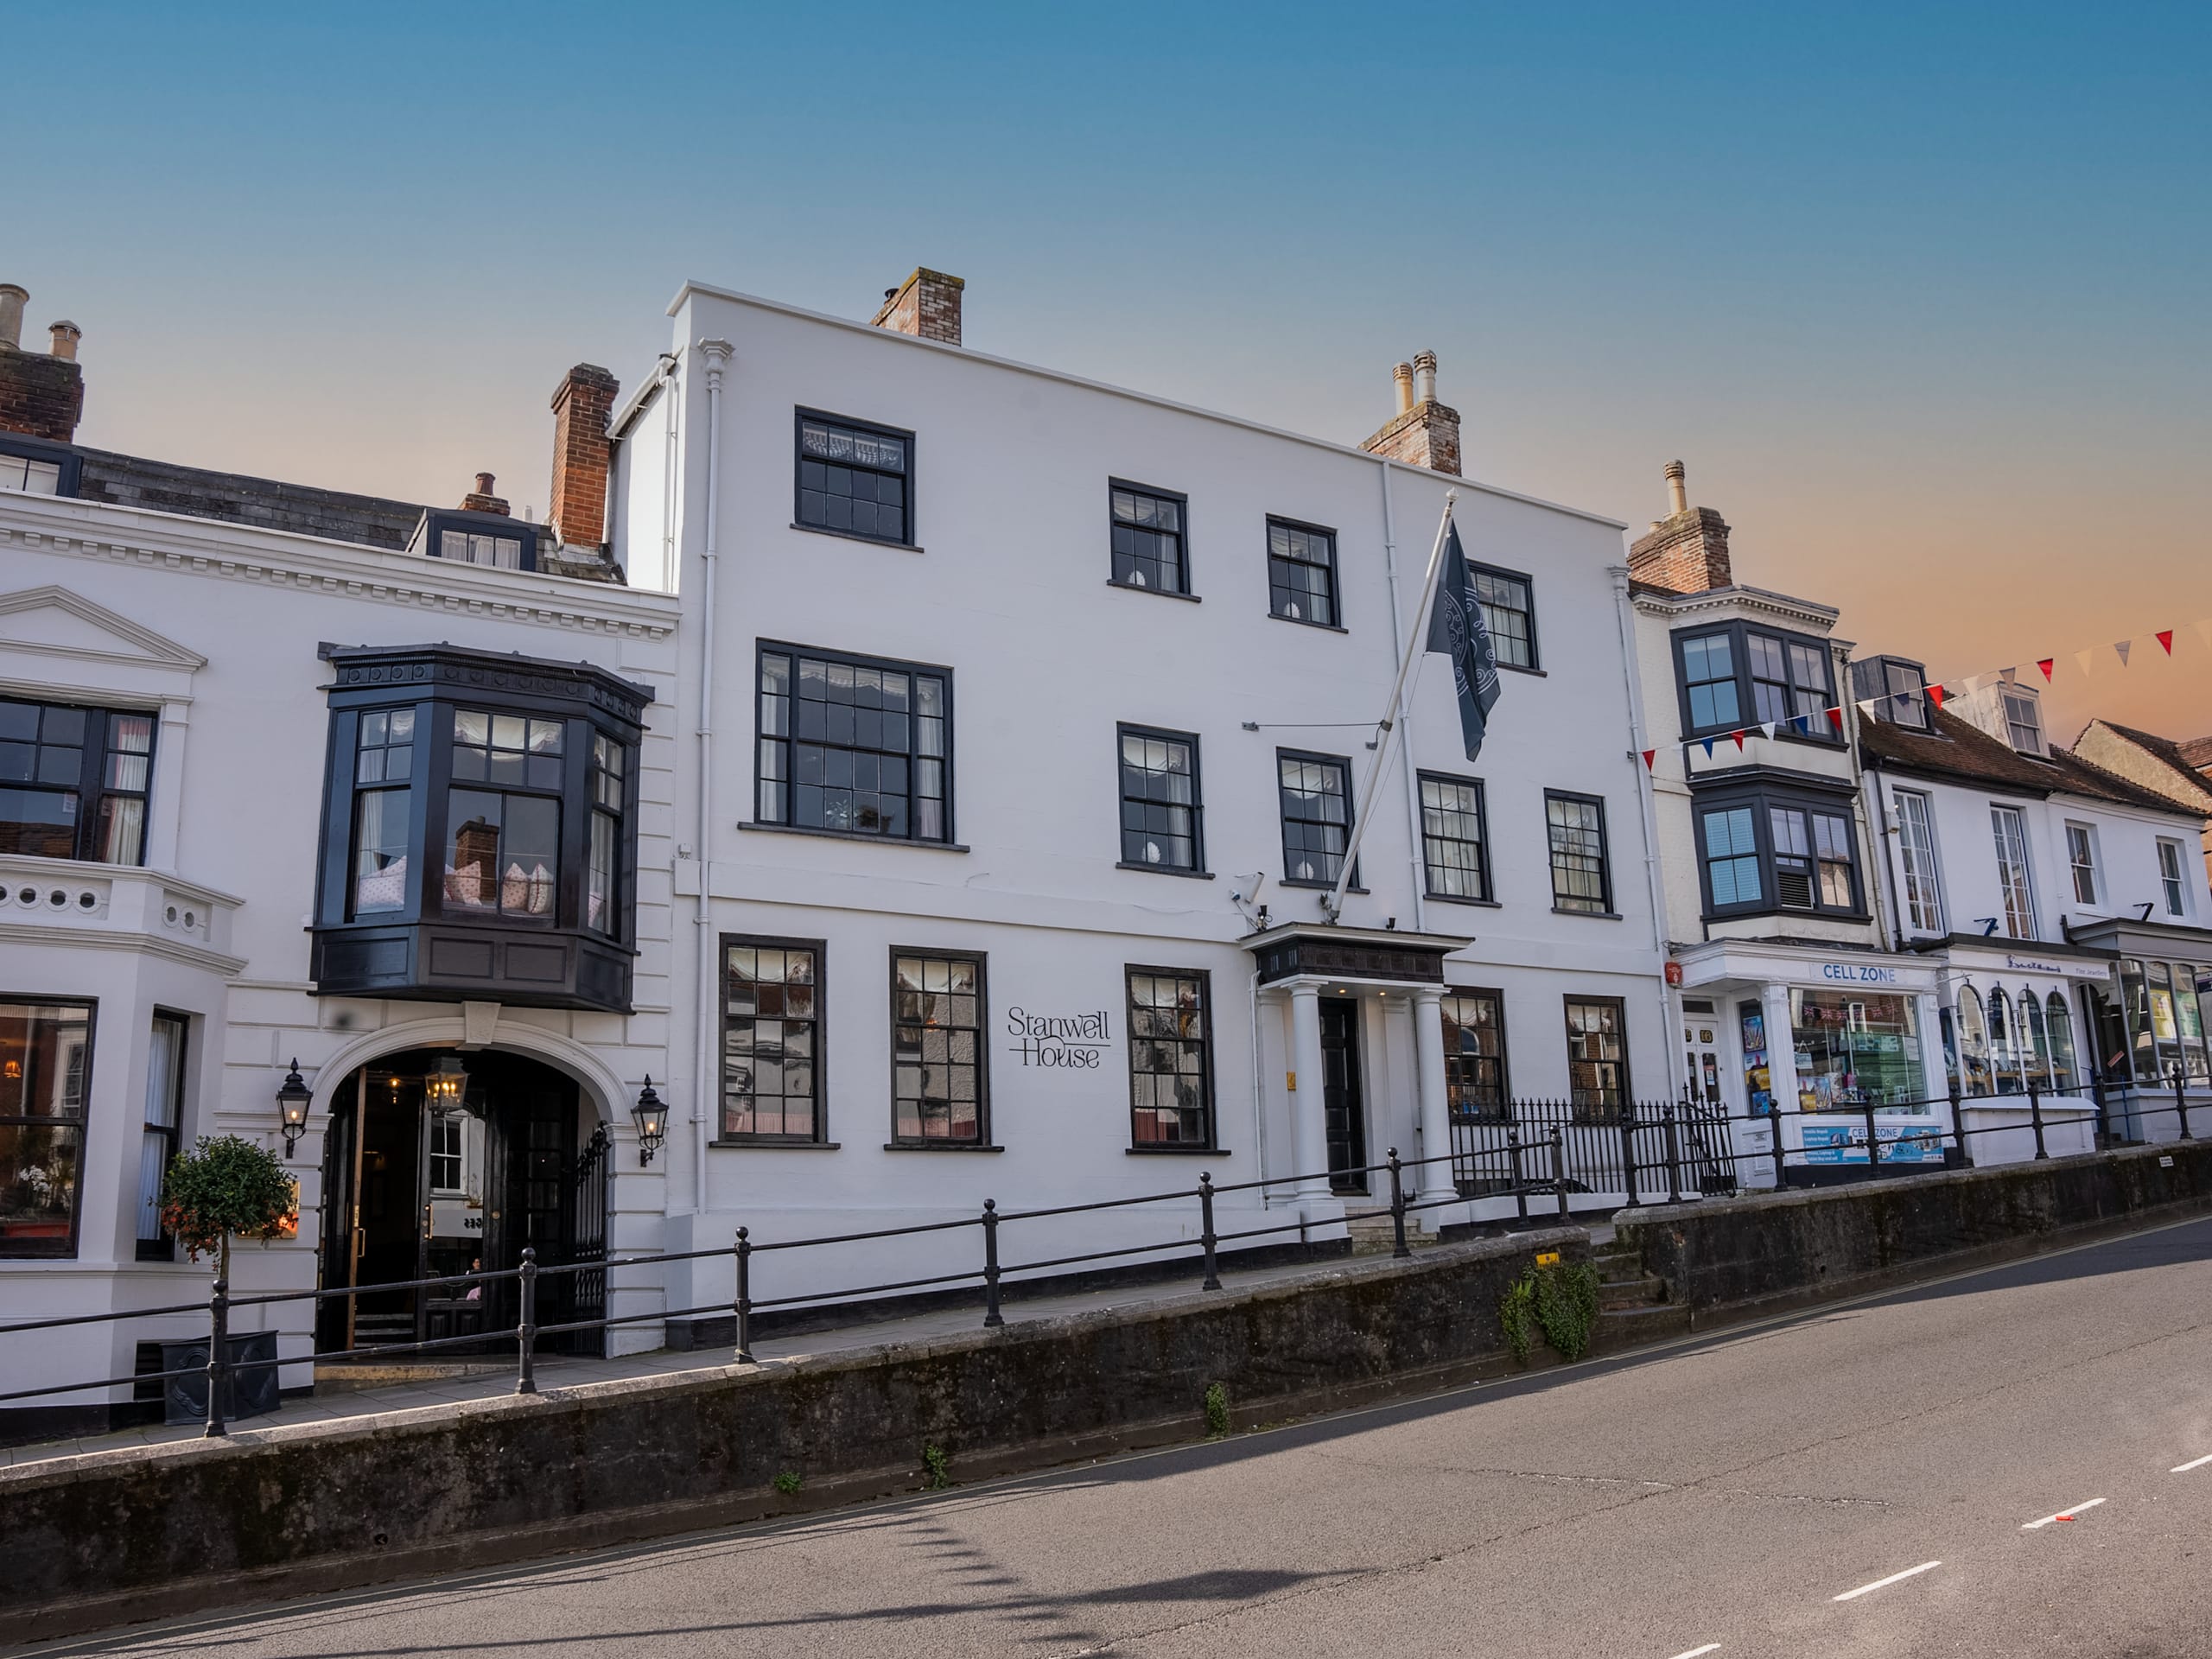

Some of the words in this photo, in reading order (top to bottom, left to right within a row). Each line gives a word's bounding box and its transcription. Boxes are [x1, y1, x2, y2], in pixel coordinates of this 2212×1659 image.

[1823, 964, 1857, 980] CELL
[1859, 967, 1897, 982] ZONE
[1007, 1007, 1110, 1039] Stanwell
[1009, 1036, 1103, 1069] House
[1852, 1128, 1870, 1138] CEL
[1875, 1128, 1898, 1138] ZONE
